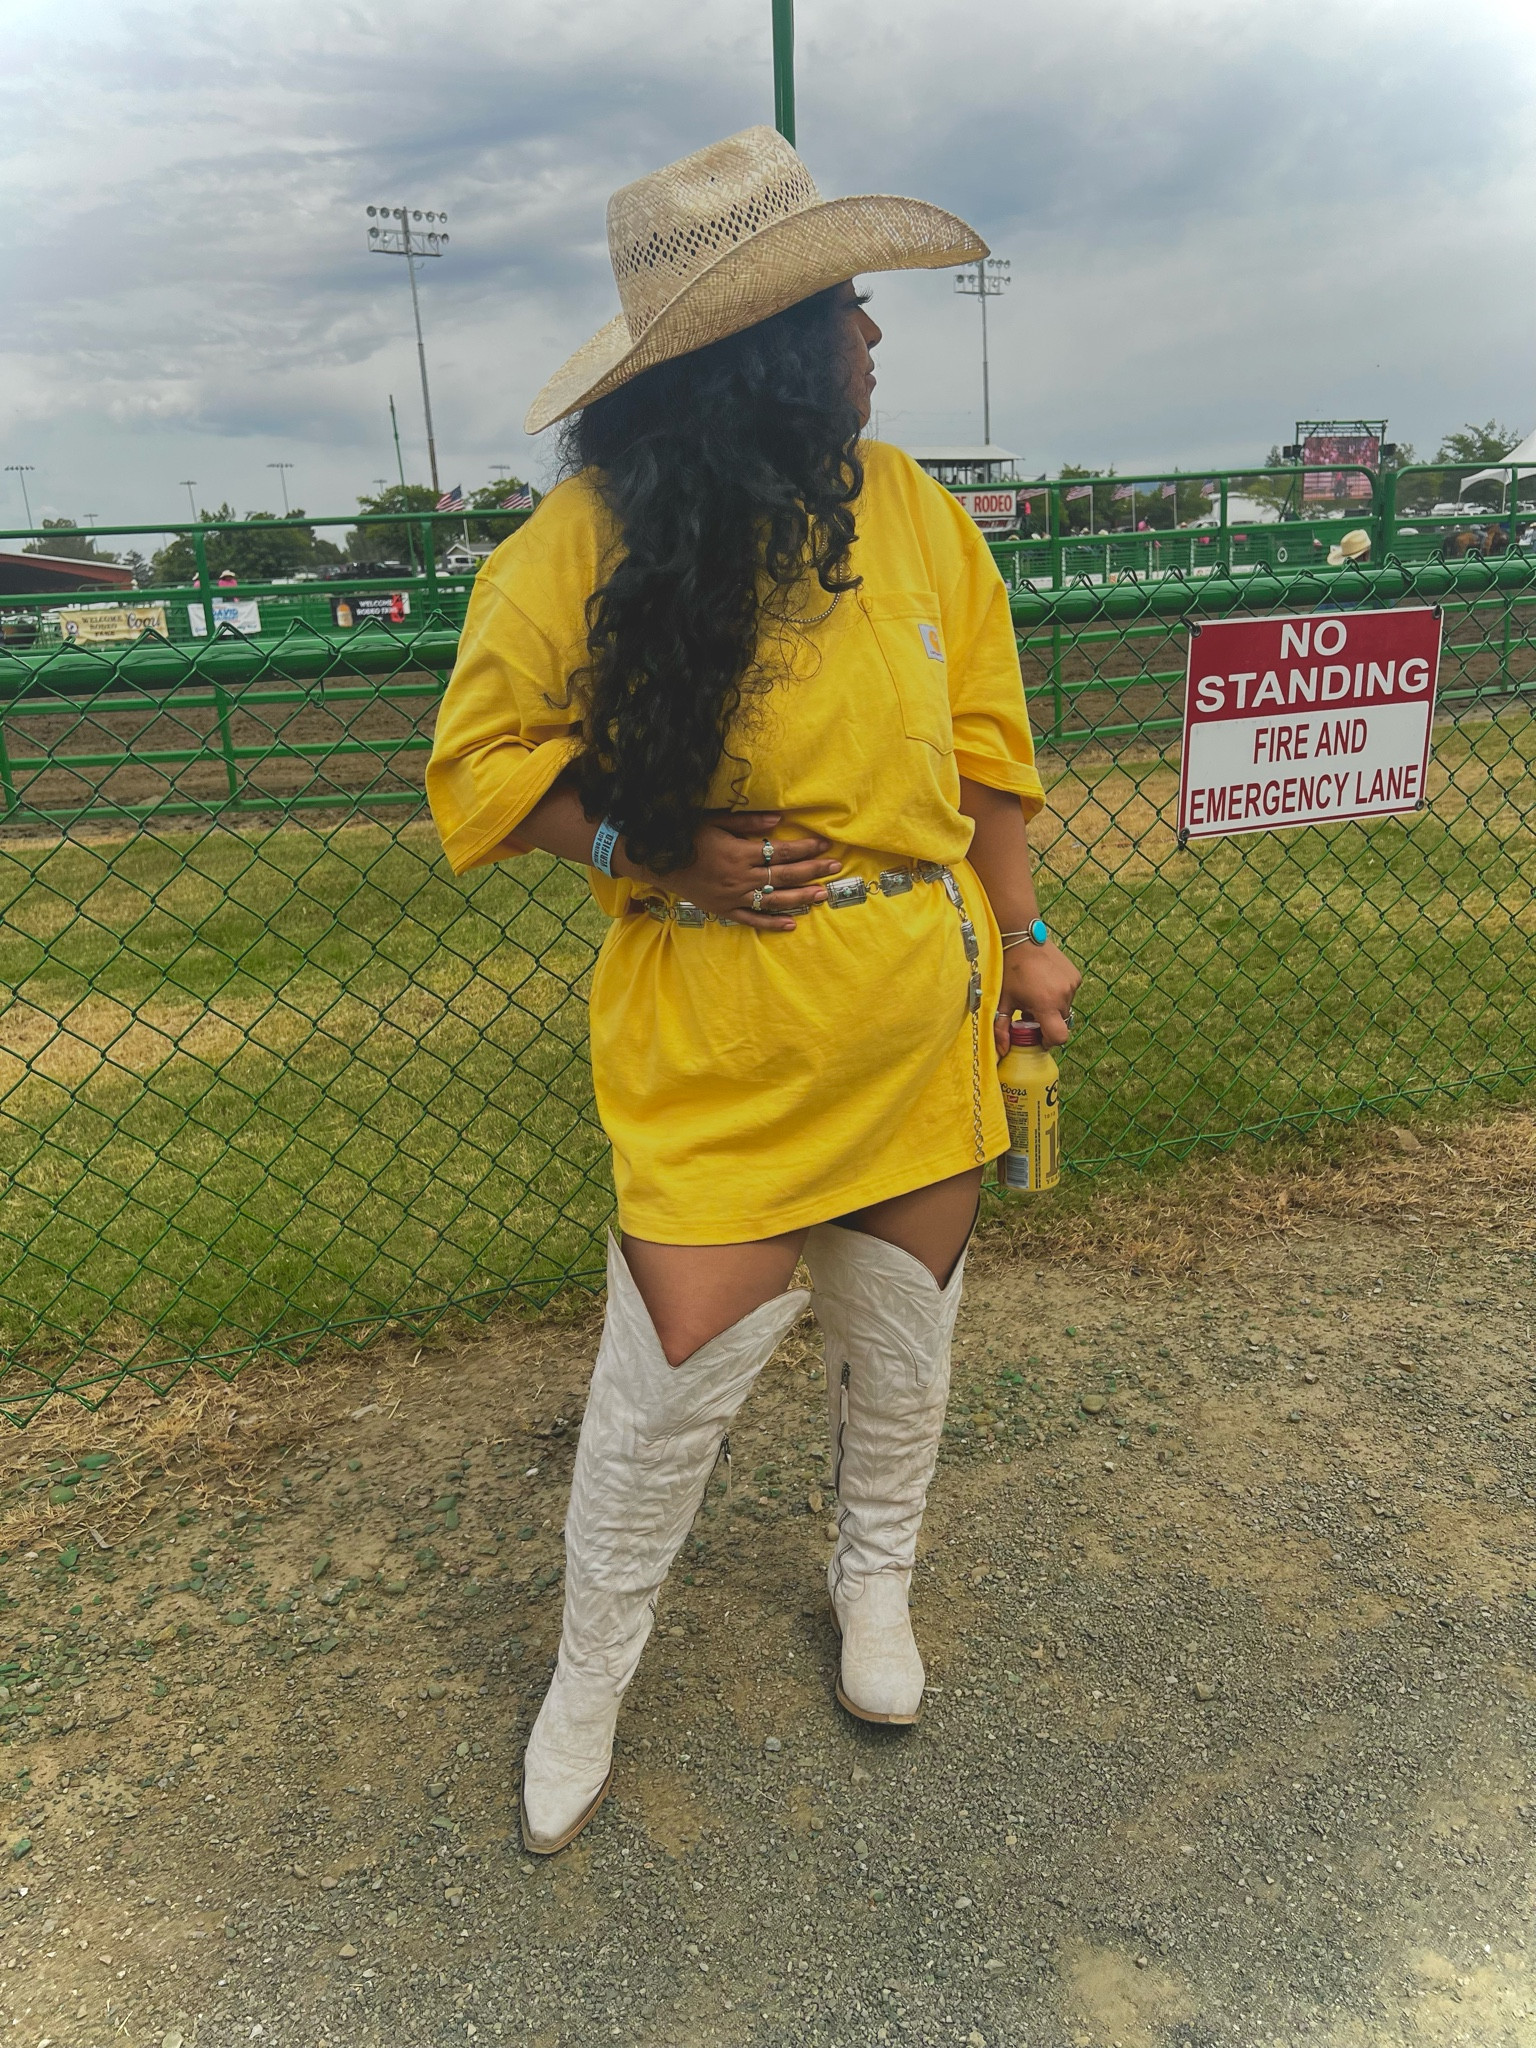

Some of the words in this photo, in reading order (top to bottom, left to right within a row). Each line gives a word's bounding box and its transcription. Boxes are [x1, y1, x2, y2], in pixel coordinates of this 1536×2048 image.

[974, 495, 1012, 513] RODEO
[82, 615, 122, 624] WELCOME
[359, 599, 393, 608] WELCOME
[1280, 620, 1347, 660] NO
[1195, 657, 1430, 713] STANDING
[1253, 723, 1310, 764] FIRE
[1314, 718, 1368, 758] AND
[1189, 772, 1350, 826] EMERGENCY
[1355, 764, 1419, 806] LANE
[599, 833, 614, 868] VERIFIED
[1000, 1082, 1028, 1097] Coors
